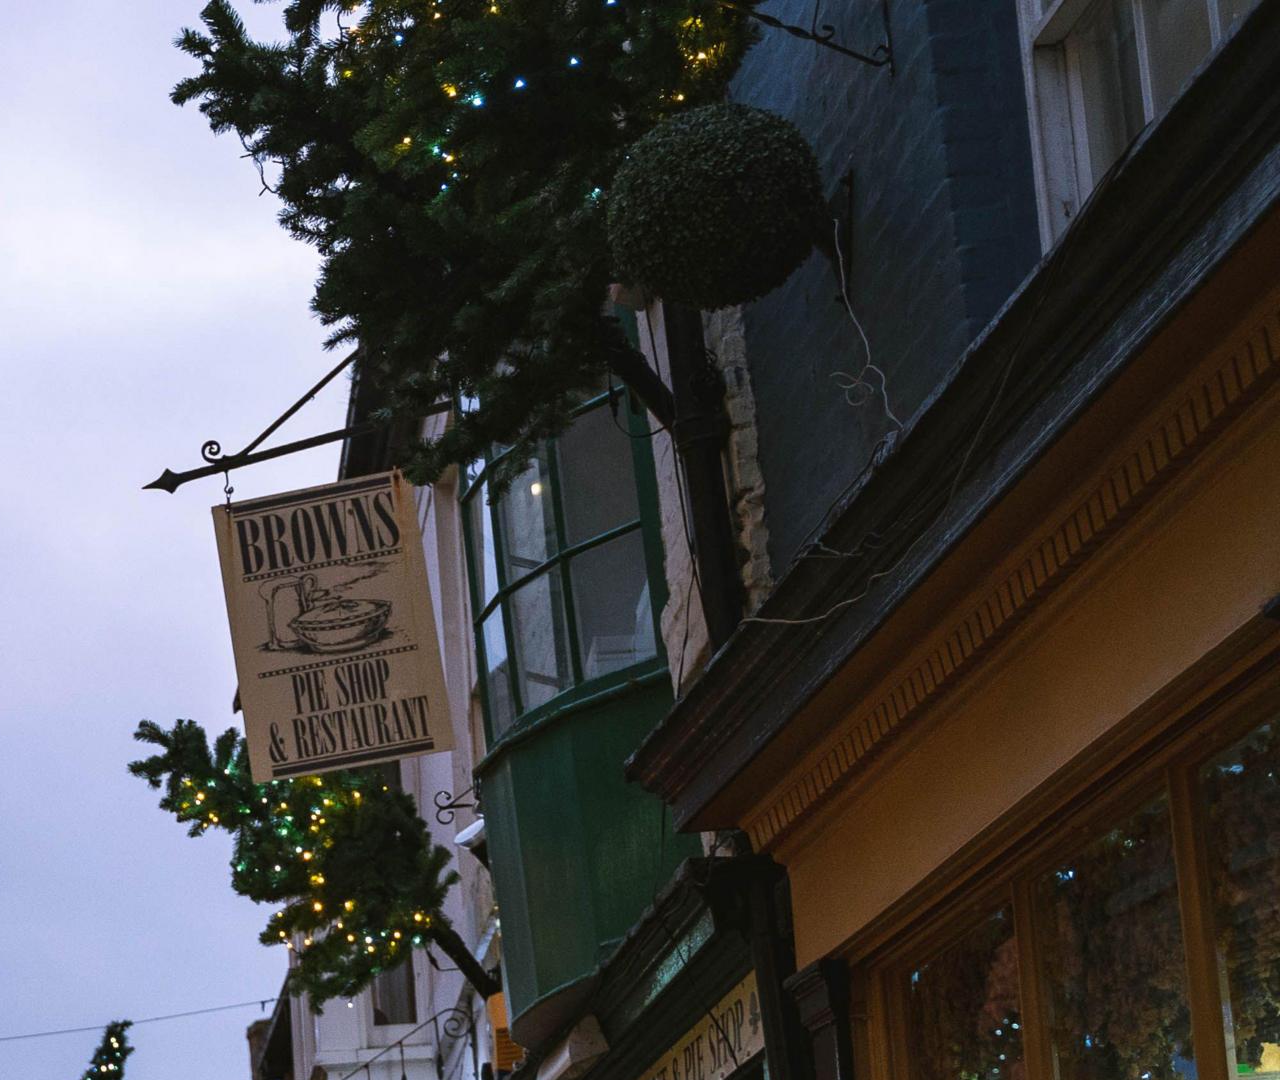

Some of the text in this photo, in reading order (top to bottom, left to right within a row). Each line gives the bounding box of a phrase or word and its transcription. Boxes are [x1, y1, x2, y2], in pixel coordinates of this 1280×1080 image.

[236, 492, 400, 575] BROWNS
[292, 658, 390, 714] PIE SHOP
[269, 695, 430, 763] & RESTAURANT
[708, 998, 744, 1074] SHOP
